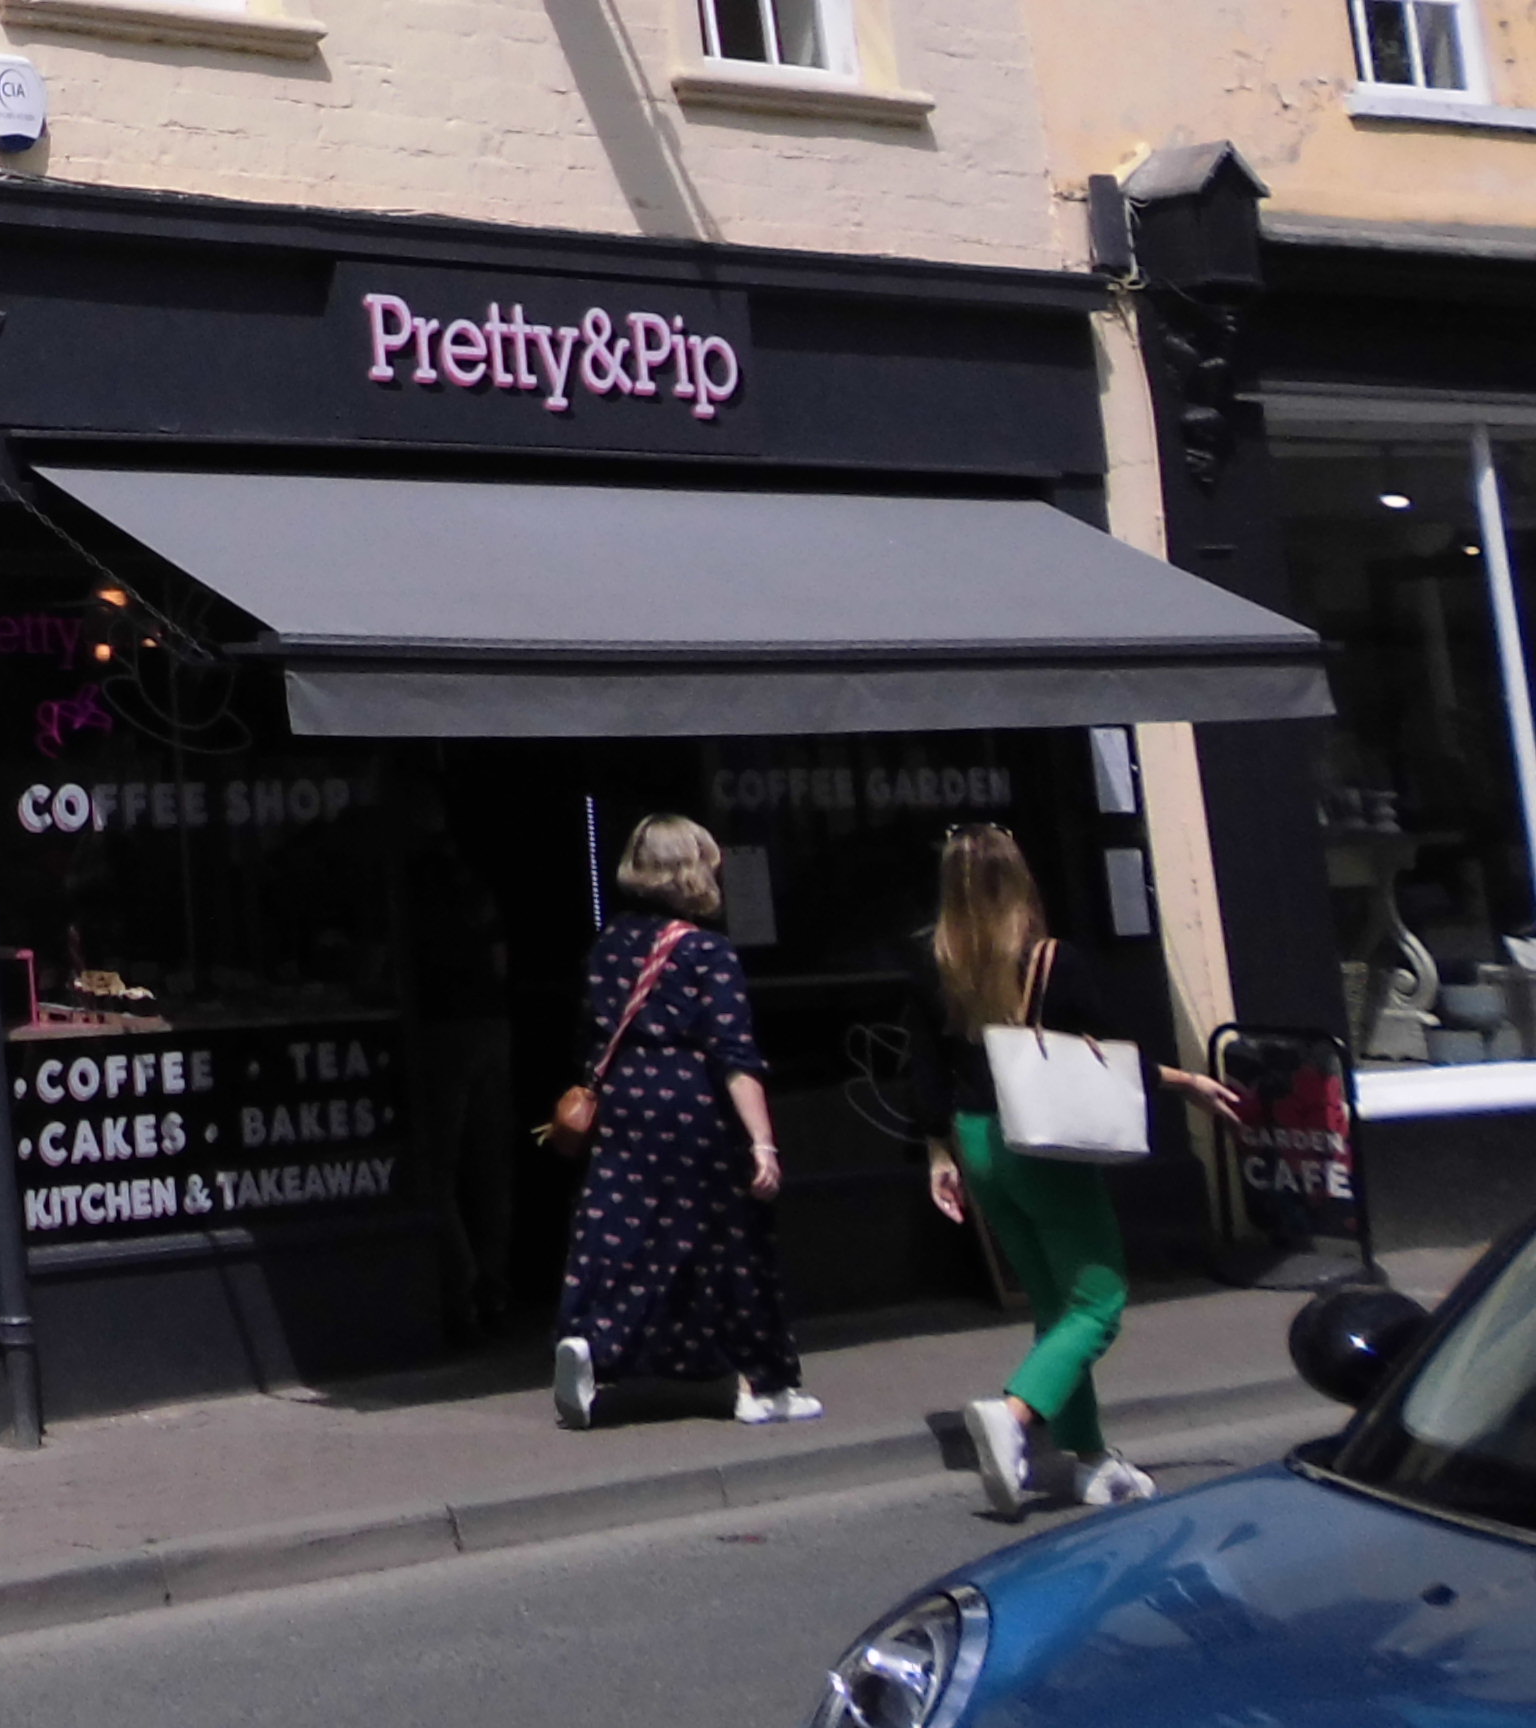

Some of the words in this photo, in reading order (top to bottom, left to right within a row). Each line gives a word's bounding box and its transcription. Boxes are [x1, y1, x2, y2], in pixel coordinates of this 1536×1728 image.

[17, 781, 209, 833] COFFEE
[227, 779, 352, 826] SHOP
[711, 767, 856, 810] COFFEE
[865, 766, 1013, 809] GARDEN
[35, 1049, 215, 1104] COFFEE
[286, 1039, 372, 1084] TEA
[37, 1110, 188, 1167] CAKES
[240, 1096, 377, 1149] BAKES
[23, 1175, 179, 1231] KITCHEN
[182, 1173, 214, 1215] &
[215, 1156, 397, 1211] TAKEAWAY
[1243, 1155, 1355, 1200] CAFE
